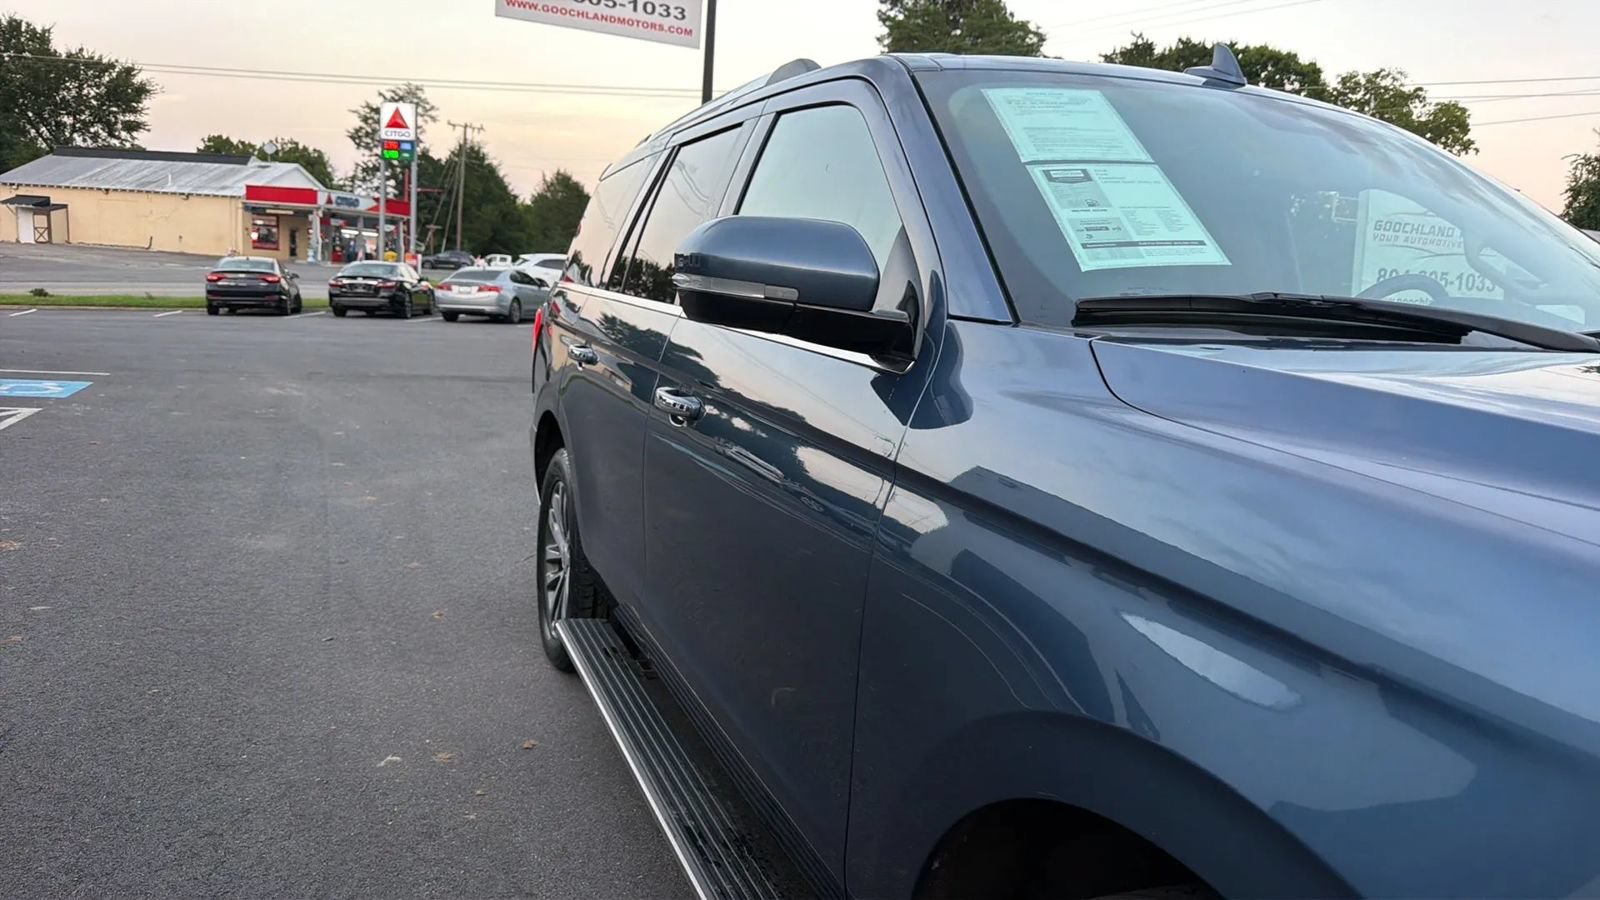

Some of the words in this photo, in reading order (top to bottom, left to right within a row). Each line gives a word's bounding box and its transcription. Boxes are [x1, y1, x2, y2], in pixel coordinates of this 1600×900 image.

[504, 0, 693, 37] WWW.GOOCHLANDMOTORS.COM
[572, 0, 687, 21] 5-1033
[384, 130, 411, 138] CITGO
[1374, 220, 1455, 237] GOOCHLAND
[1373, 233, 1399, 241] YOUR
[1403, 237, 1462, 248] AUTOMOTIVE
[1377, 268, 1496, 291] 85-1033
